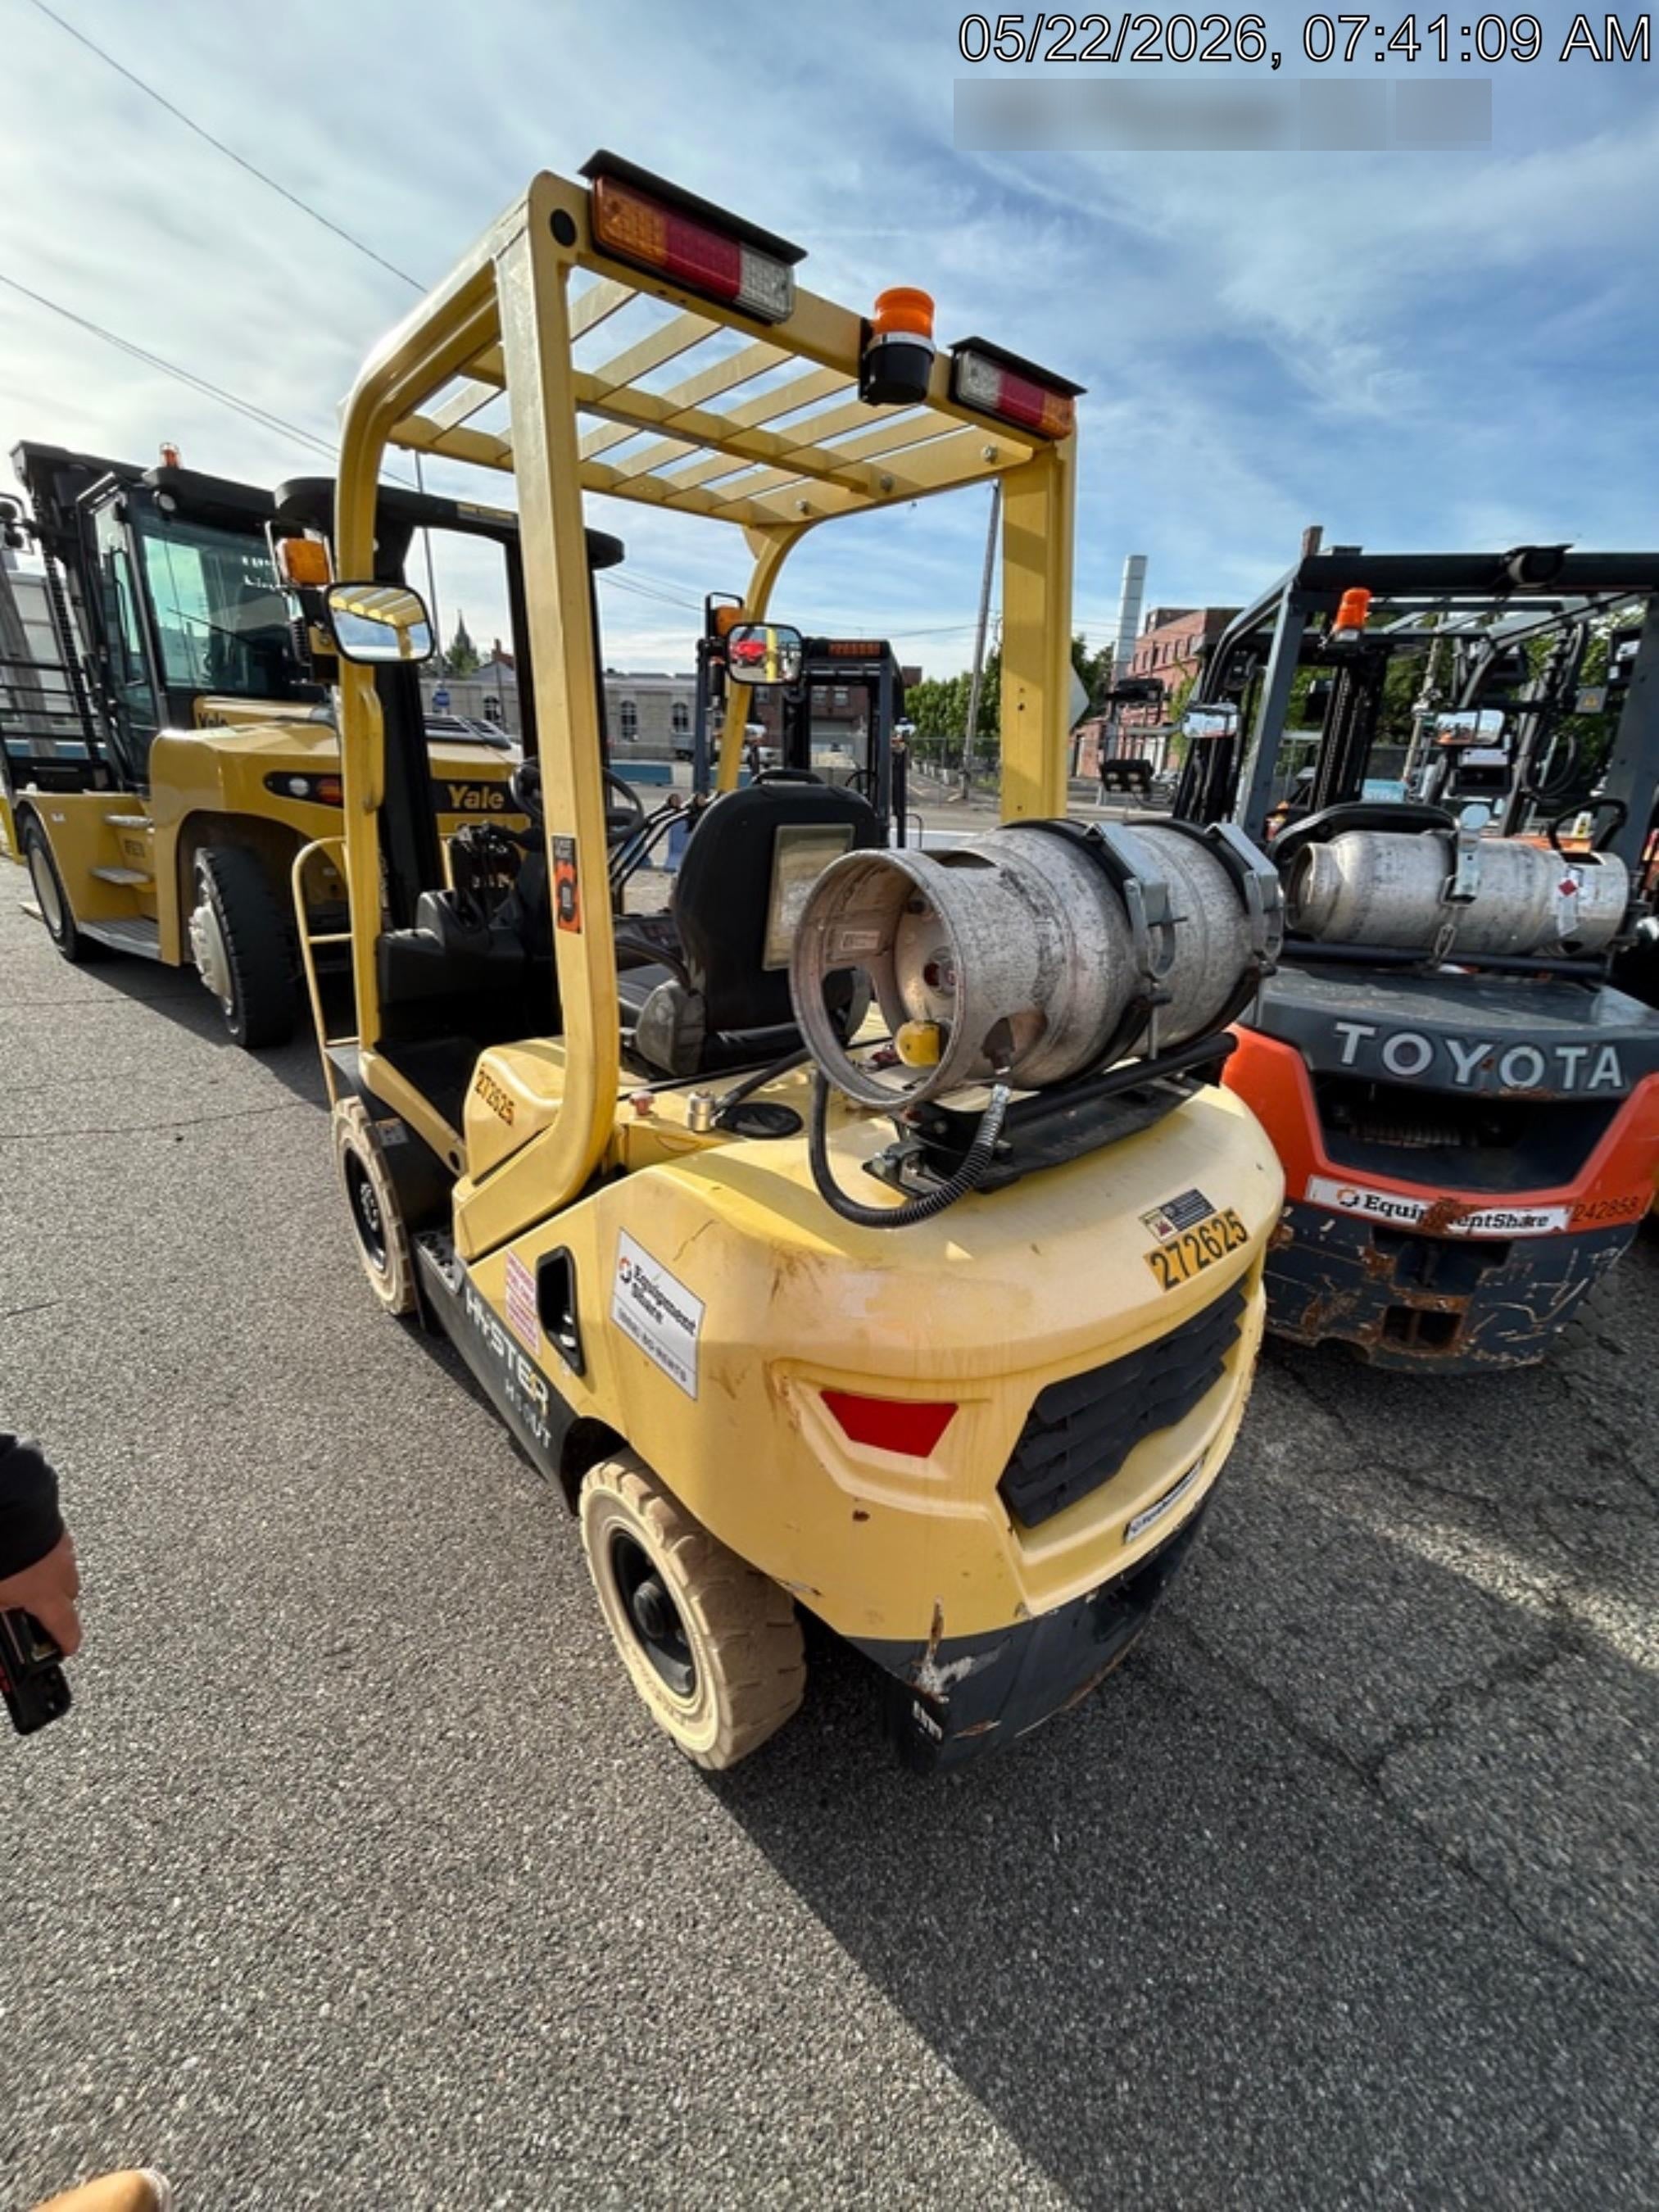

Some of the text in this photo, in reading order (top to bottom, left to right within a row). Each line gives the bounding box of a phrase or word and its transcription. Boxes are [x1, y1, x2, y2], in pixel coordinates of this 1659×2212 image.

[448, 784, 505, 809] Yale
[1335, 1022, 1623, 1090] TOYOTA
[1149, 1211, 1248, 1290] 272625
